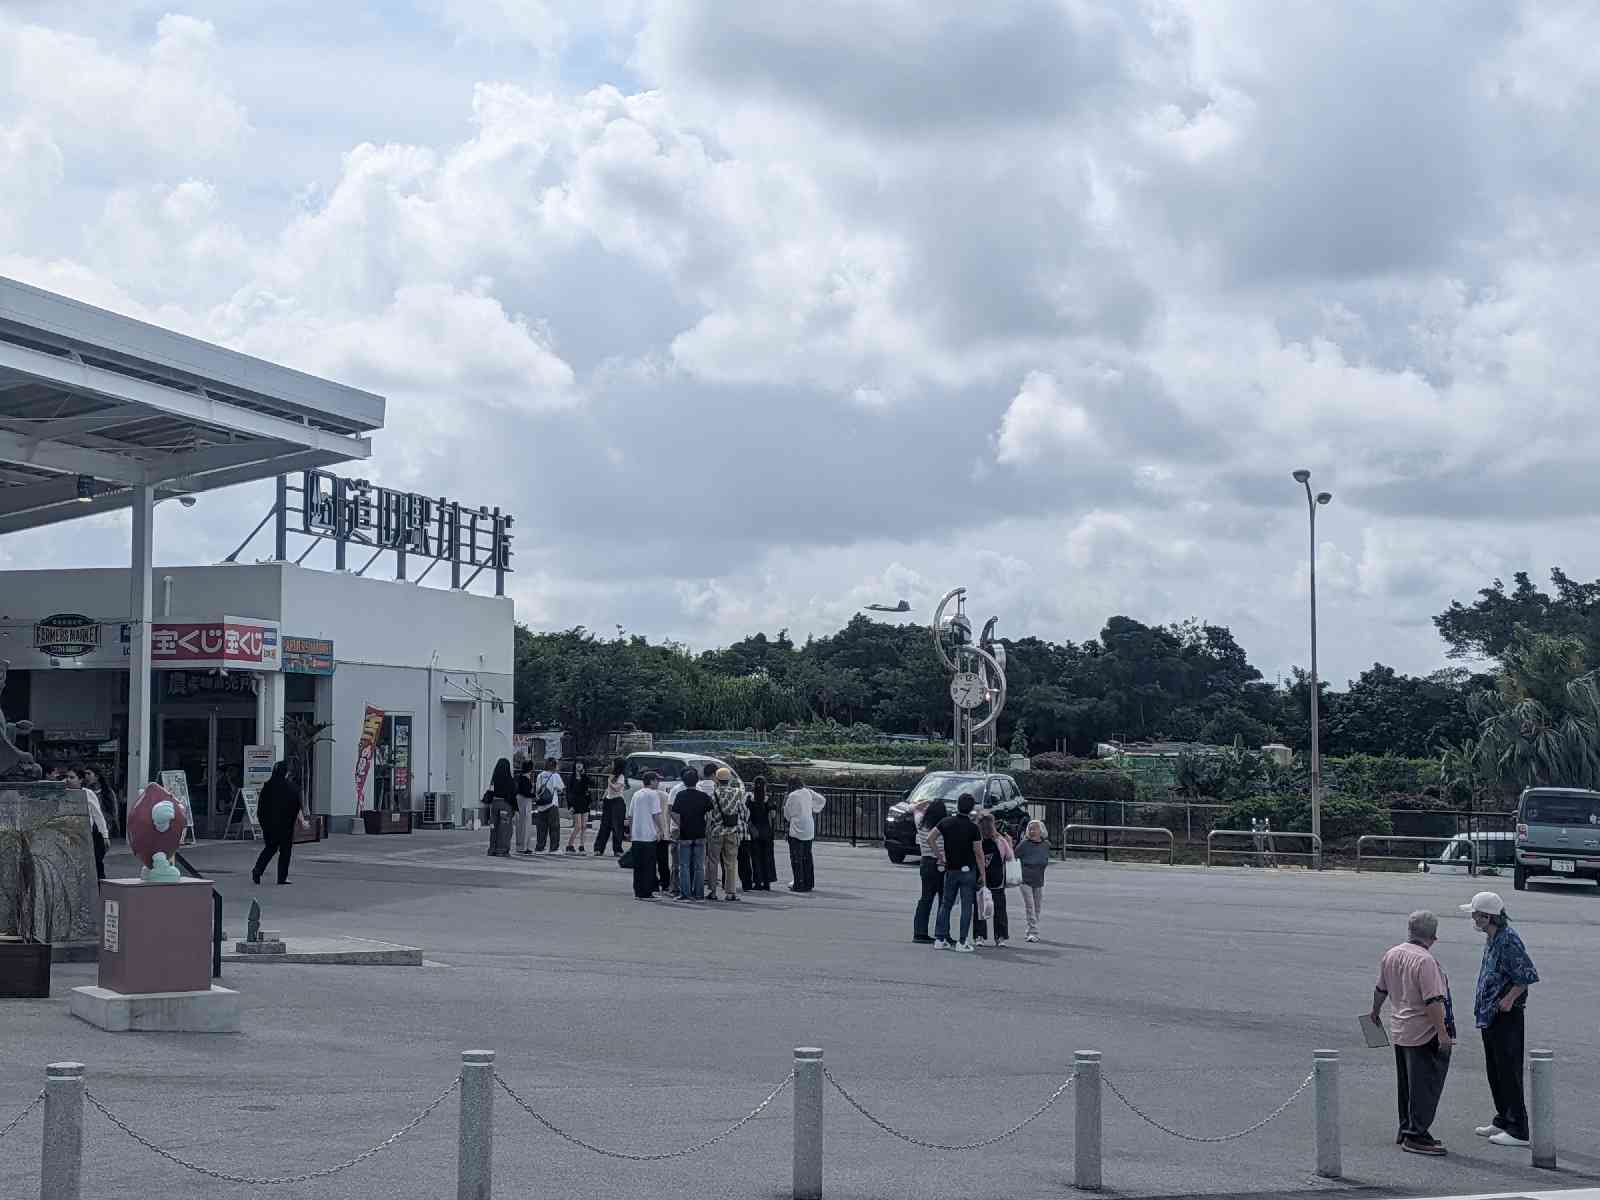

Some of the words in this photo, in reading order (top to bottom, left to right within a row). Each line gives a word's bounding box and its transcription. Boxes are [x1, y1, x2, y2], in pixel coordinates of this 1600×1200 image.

[152, 629, 223, 655] 宝くじ
[224, 629, 262, 655] 宝くじ
